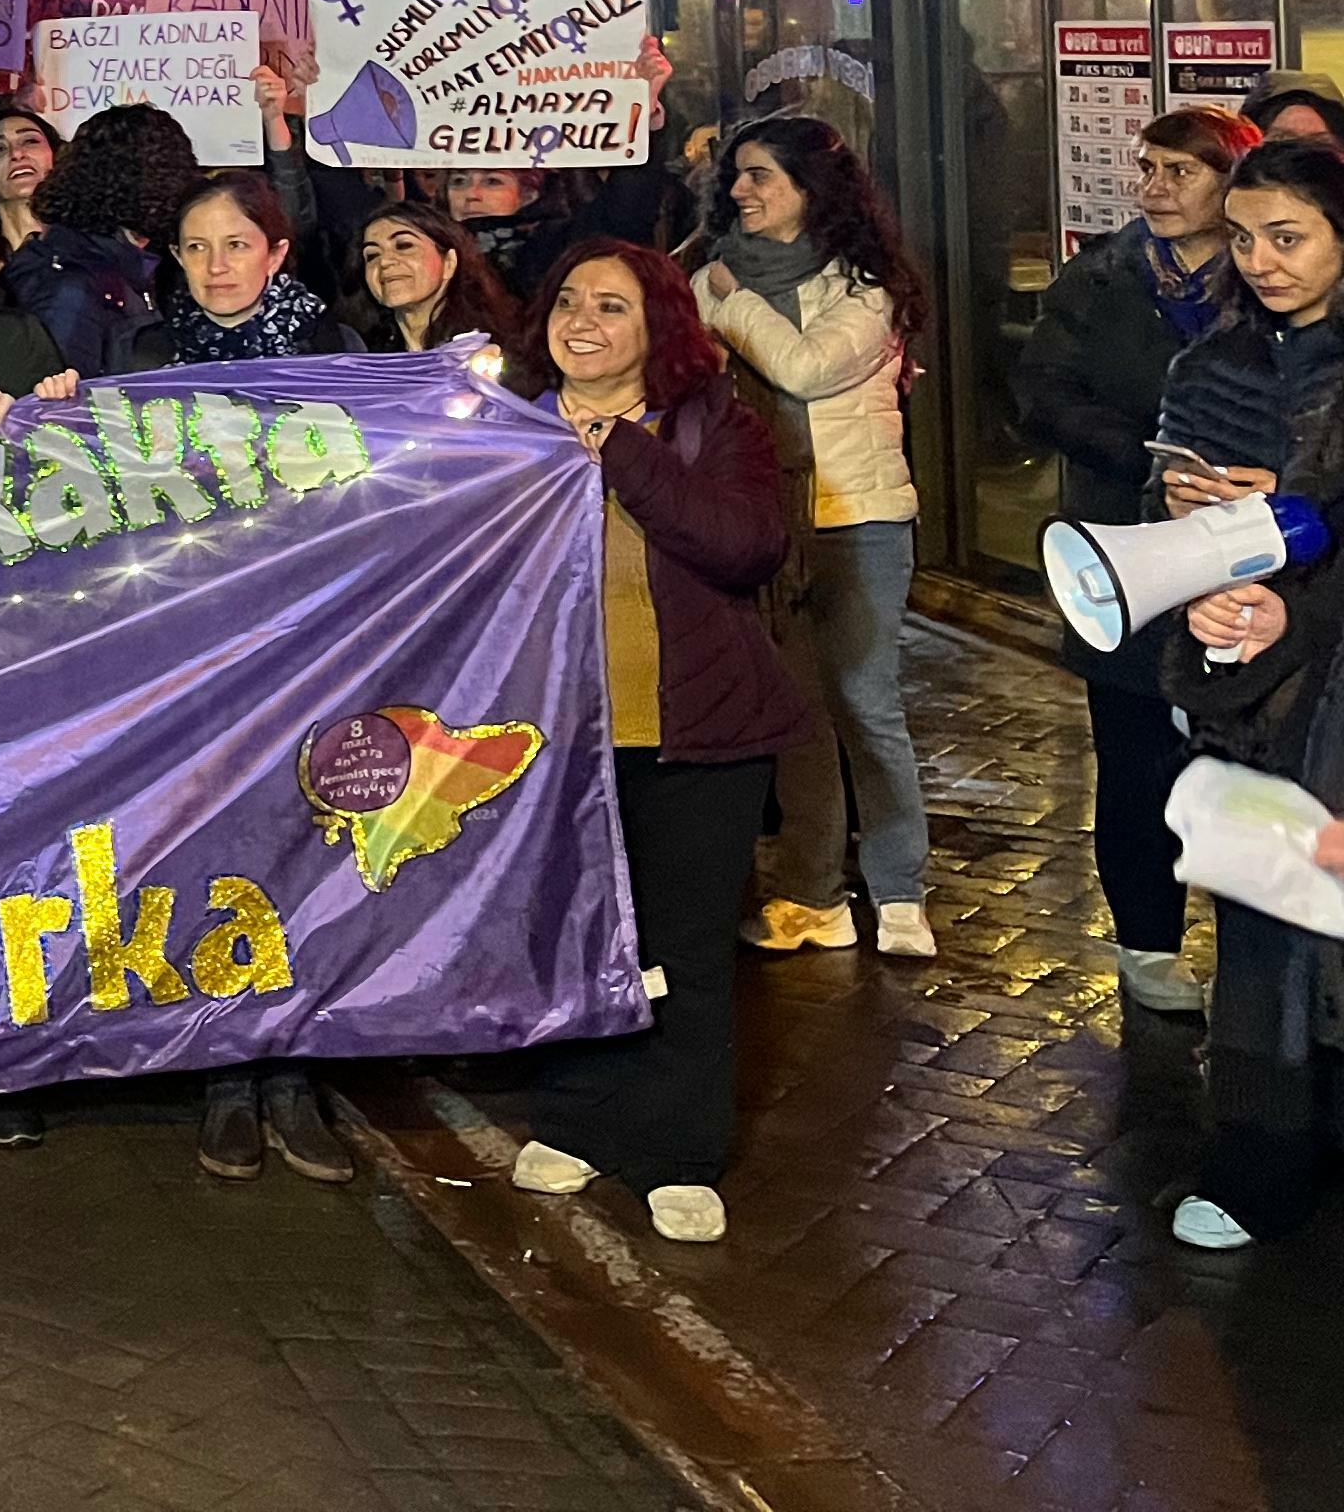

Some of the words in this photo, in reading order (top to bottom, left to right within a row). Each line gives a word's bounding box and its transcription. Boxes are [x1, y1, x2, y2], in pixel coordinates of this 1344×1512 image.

[50, 21, 119, 50] BAĞZI
[139, 22, 247, 46] KADINLAR
[89, 58, 171, 83] YEMEK
[186, 53, 250, 80] DEĞİL
[416, 62, 482, 105] İTAAT
[163, 85, 243, 108] YAPAR
[350, 720, 363, 738] 8
[341, 736, 372, 750] mart
[334, 748, 383, 767] ankara
[320, 768, 369, 786] feminist
[371, 766, 402, 780] gece
